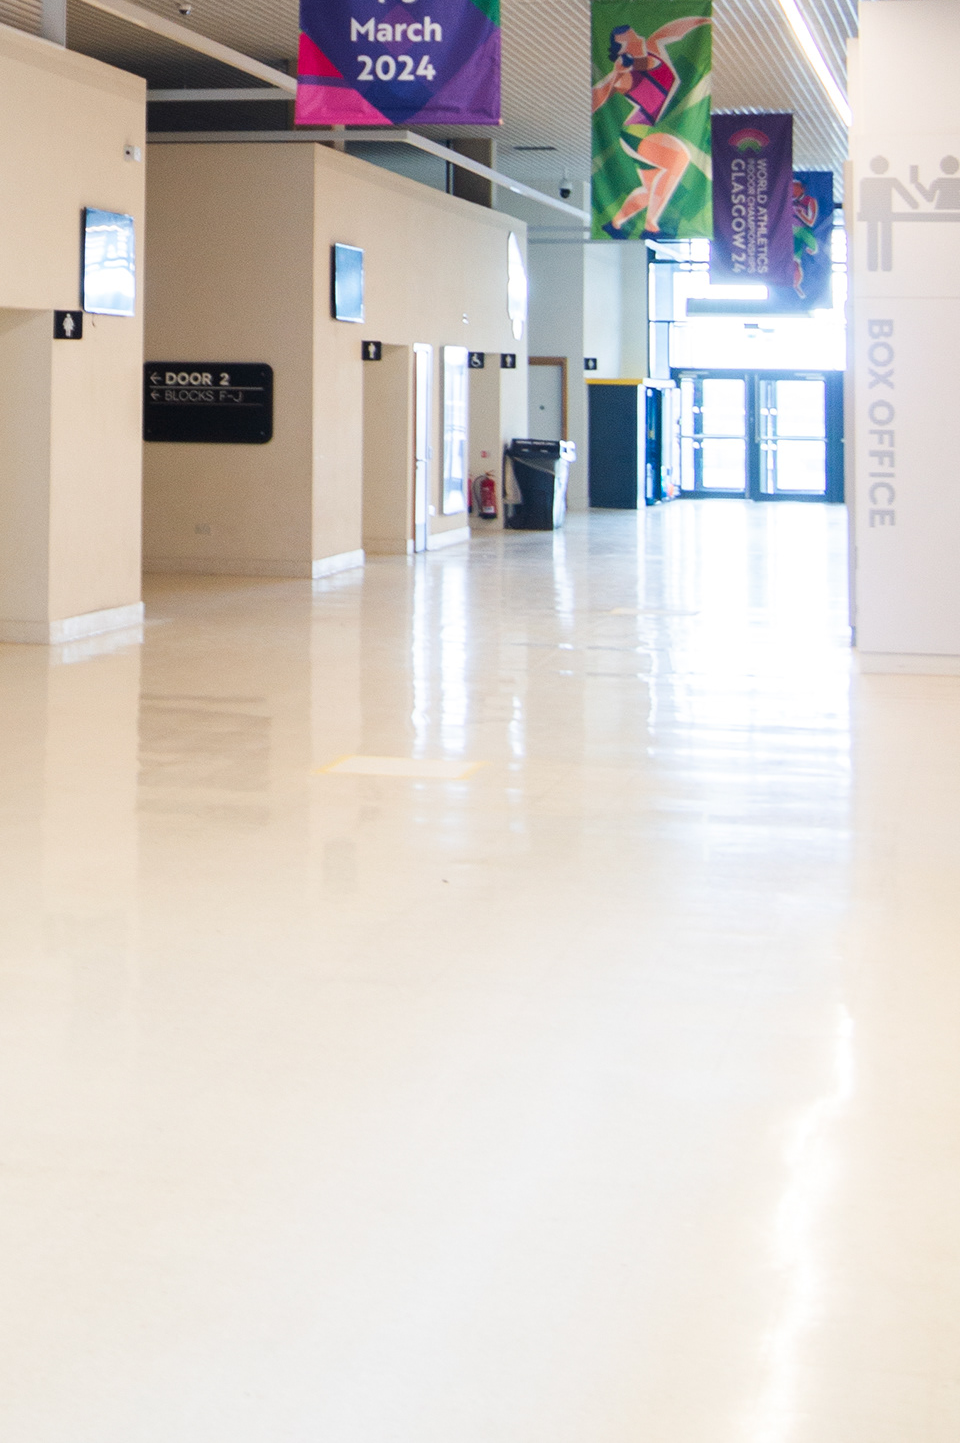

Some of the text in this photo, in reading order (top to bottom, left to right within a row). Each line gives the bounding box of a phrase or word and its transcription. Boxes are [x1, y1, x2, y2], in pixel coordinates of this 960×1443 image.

[350, 15, 443, 43] March
[356, 54, 437, 81] 2024
[730, 158, 747, 273] GLASGOW 24
[756, 159, 769, 273] WORLD ATHLETICS
[165, 372, 230, 386] DOOR 2
[164, 390, 214, 402] BLOCKS
[867, 318, 896, 529] BOX OFFICE
